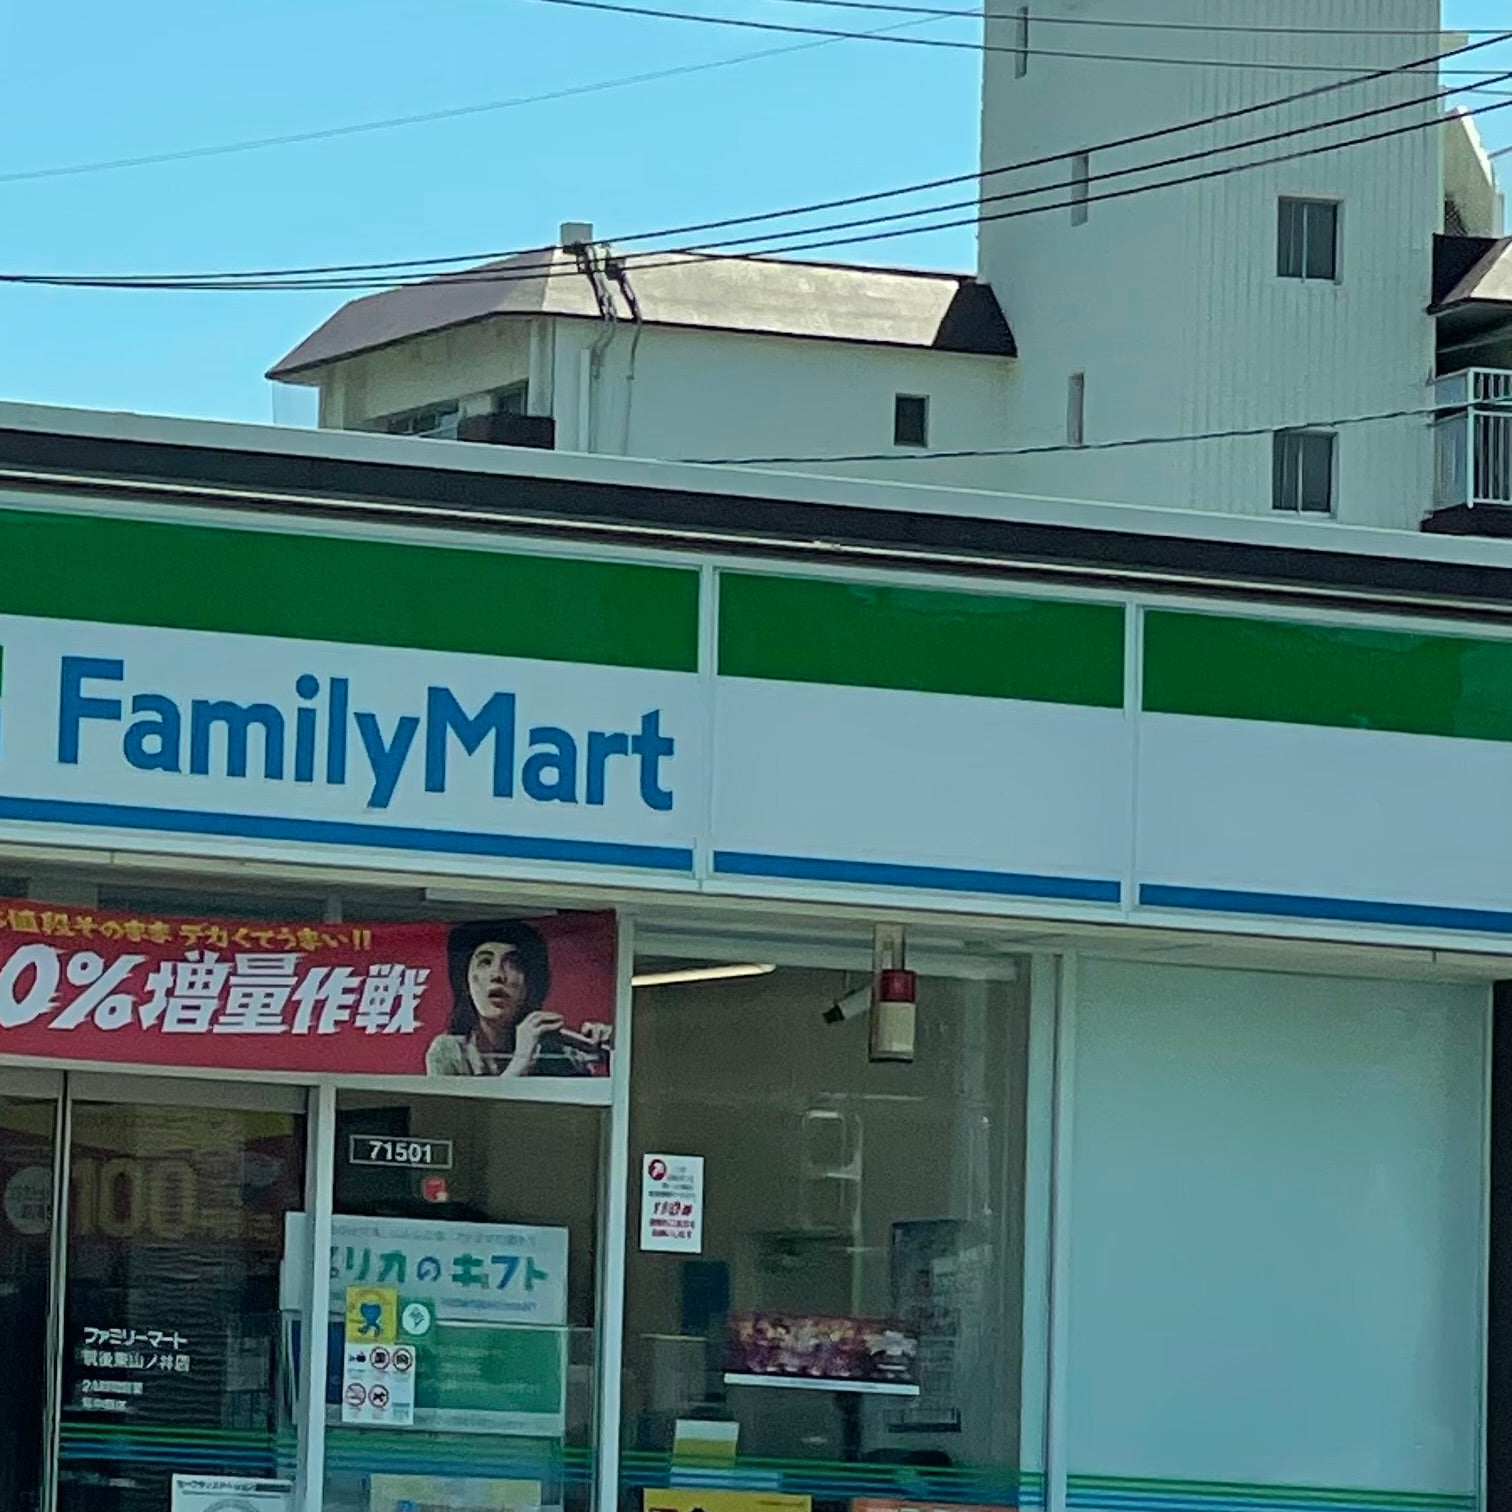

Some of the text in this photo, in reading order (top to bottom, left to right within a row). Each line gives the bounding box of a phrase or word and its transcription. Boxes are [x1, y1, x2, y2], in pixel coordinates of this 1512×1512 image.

[58, 655, 675, 812] FamilyMart
[369, 1139, 433, 1164] 71501
[83, 1326, 189, 1350] ファミリーマート
